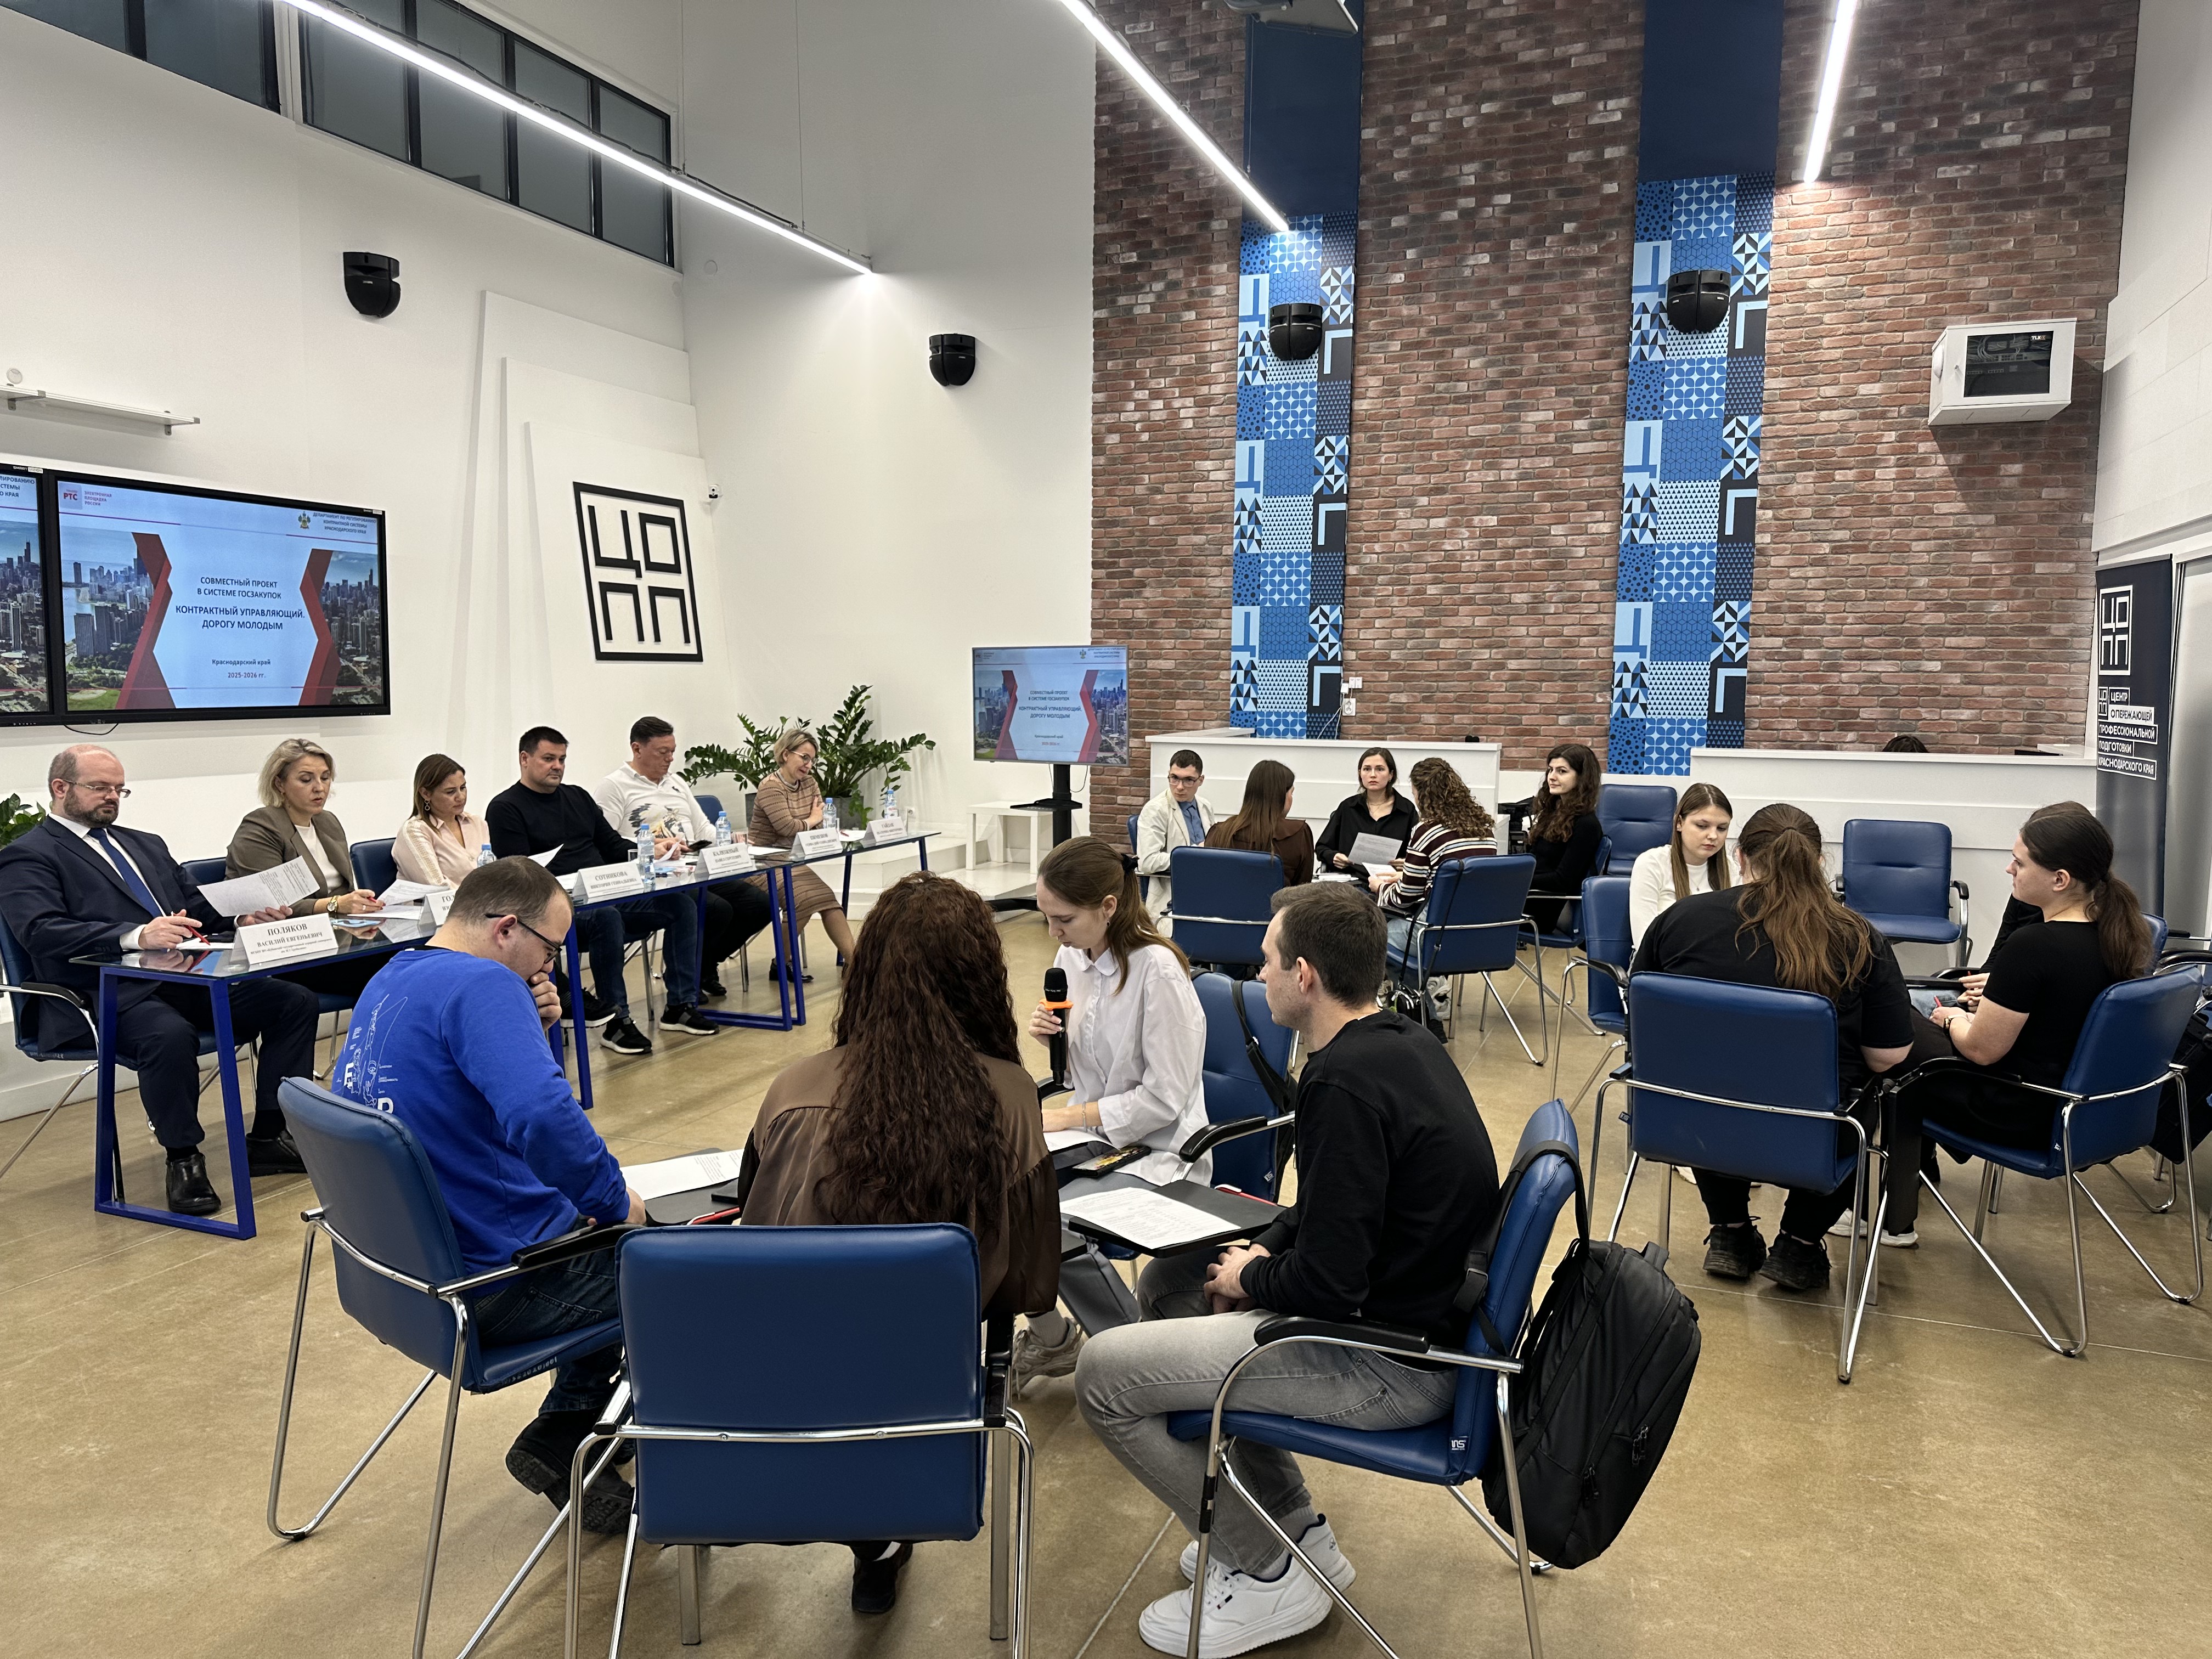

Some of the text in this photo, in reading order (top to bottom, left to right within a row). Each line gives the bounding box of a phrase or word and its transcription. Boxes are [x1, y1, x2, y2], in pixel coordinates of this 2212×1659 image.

[63, 492, 78, 500] РТС
[200, 577, 278, 588] СОВМЕСТНЫЙ ПРОЕКТ
[204, 588, 236, 597] СИСТЕМЕ
[238, 591, 281, 599] ГОСЗАКУПОК
[176, 605, 306, 619] КОНТРАКТНЫЙ УПРАВЛЯЮЩИЙ.
[202, 619, 283, 631] ДОРОГУ МОЛОДЫМ
[2111, 692, 2128, 703] ЦЕНТР
[2111, 709, 2152, 723] ОПЕРЕЖАЮЩЕЙ
[2098, 724, 2155, 740] ПРОФЕССИОНАЛЬНОЙ
[2098, 740, 2132, 754] ПОДГОТОВКИ
[2098, 757, 2154, 775] КРАСНОДАРСКОГО КРАЯ
[595, 871, 628, 881] СОТНИКОВА
[267, 923, 308, 936] ПОЛЯКОВ
[257, 936, 286, 947] ВАСИЛИЙ
[286, 932, 323, 943] ЕВГЕНЬЕВИЧ
